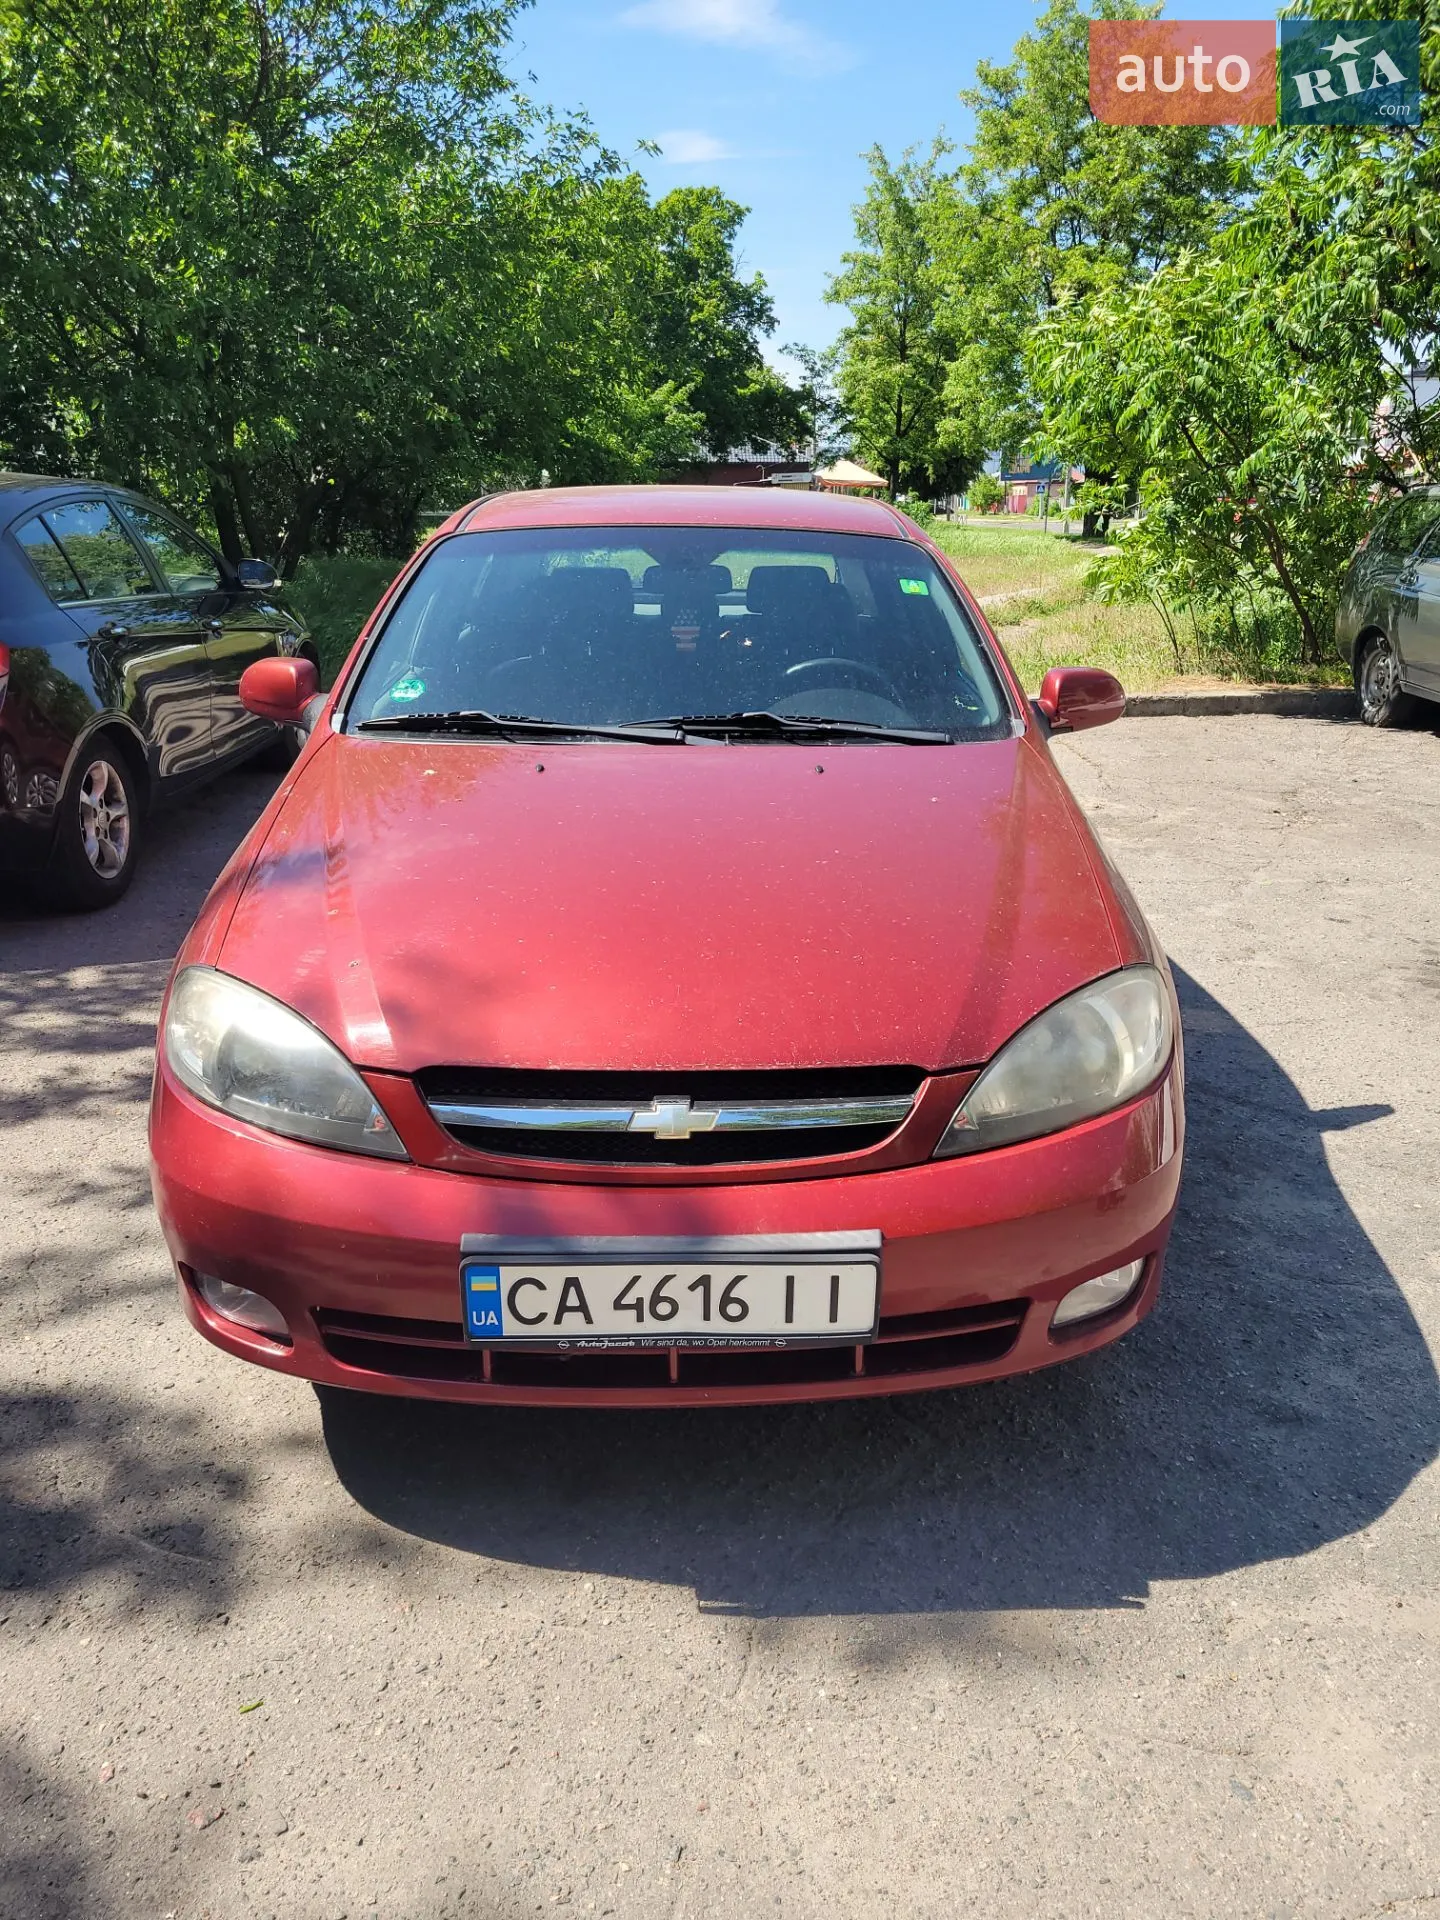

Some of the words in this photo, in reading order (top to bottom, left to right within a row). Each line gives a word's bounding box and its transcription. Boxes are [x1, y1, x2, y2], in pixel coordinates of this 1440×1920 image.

[507, 1277, 594, 1325] CA
[613, 1274, 750, 1323] 4616
[472, 1311, 499, 1326] UA
[641, 1339, 655, 1347] Wir
[657, 1338, 674, 1347] sind
[707, 1338, 727, 1348] Opel
[729, 1338, 770, 1347] herkommt
